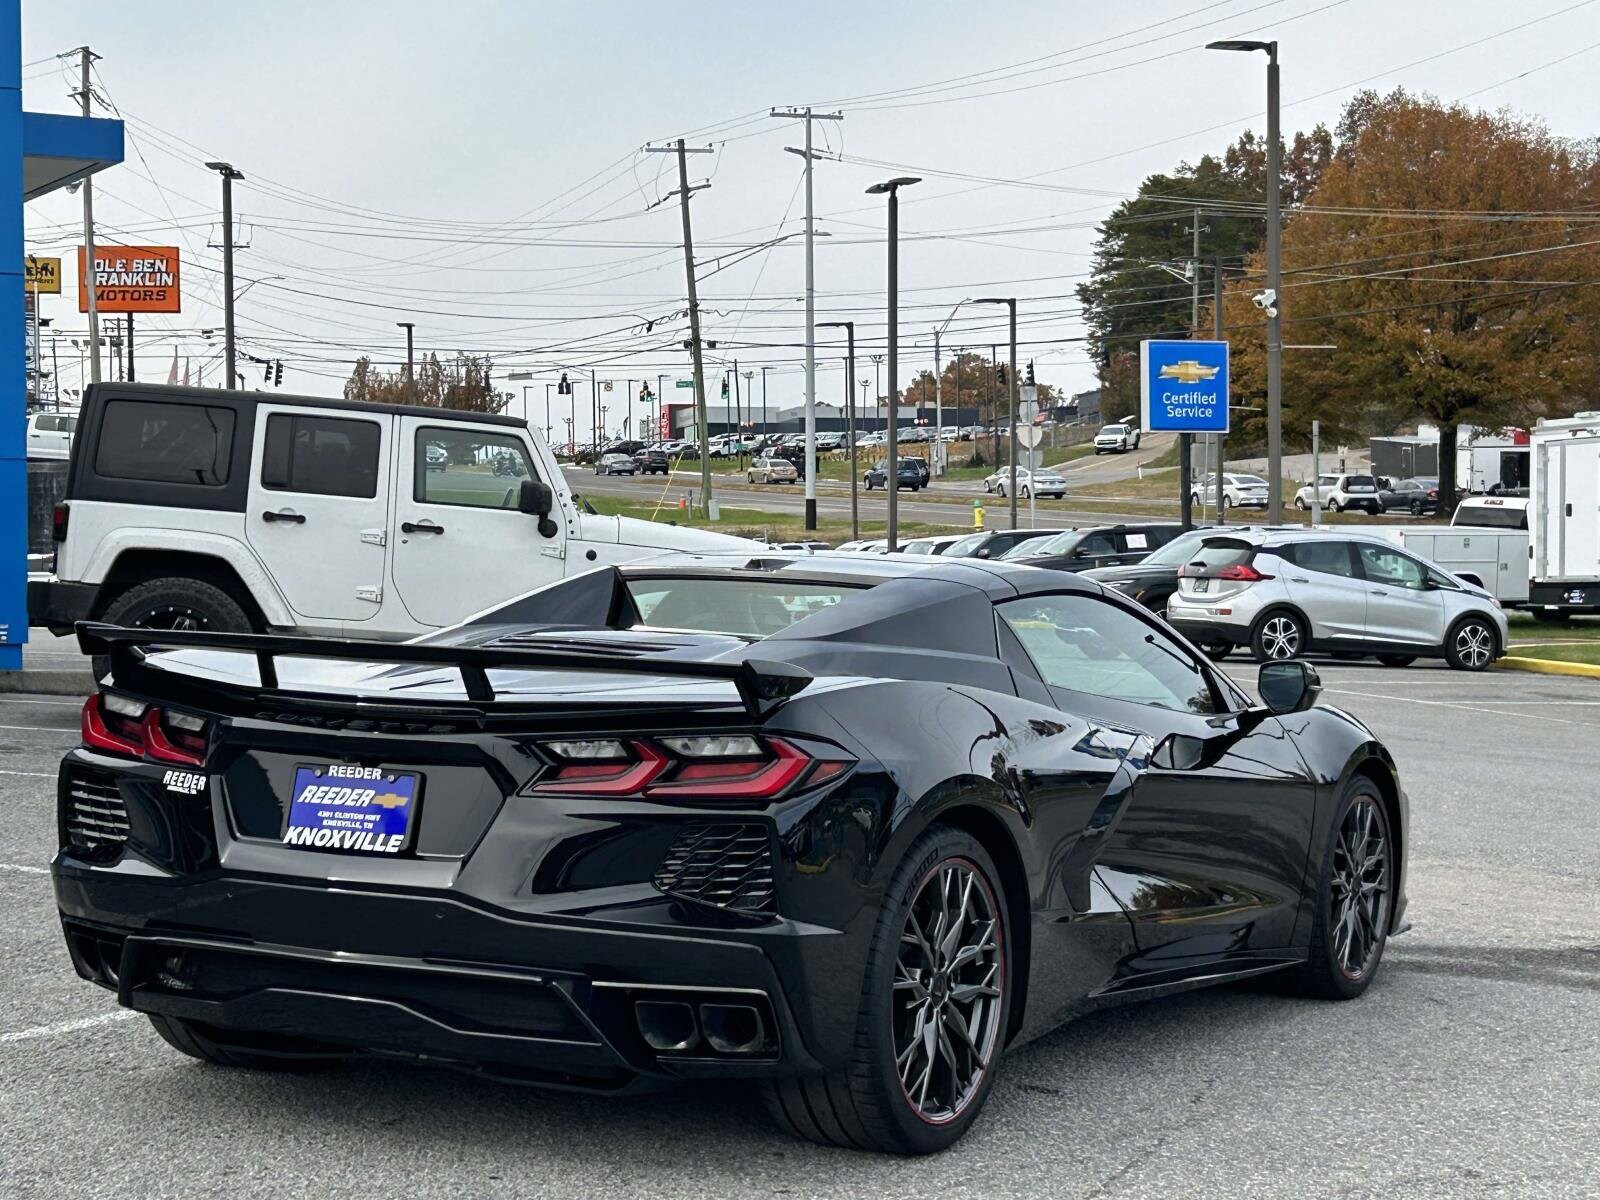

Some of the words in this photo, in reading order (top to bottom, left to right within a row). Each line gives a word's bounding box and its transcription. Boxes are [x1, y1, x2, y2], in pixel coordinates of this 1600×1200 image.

[94, 258, 127, 272] OLE
[132, 258, 167, 272] BEN
[85, 272, 174, 286] RANKLIN
[1162, 391, 1217, 405] Certified
[1166, 406, 1213, 417] Service
[328, 765, 382, 780] REEDER
[163, 770, 207, 791] REEDER
[297, 785, 376, 807] REEDER
[282, 825, 404, 853] KNOXVILLE
